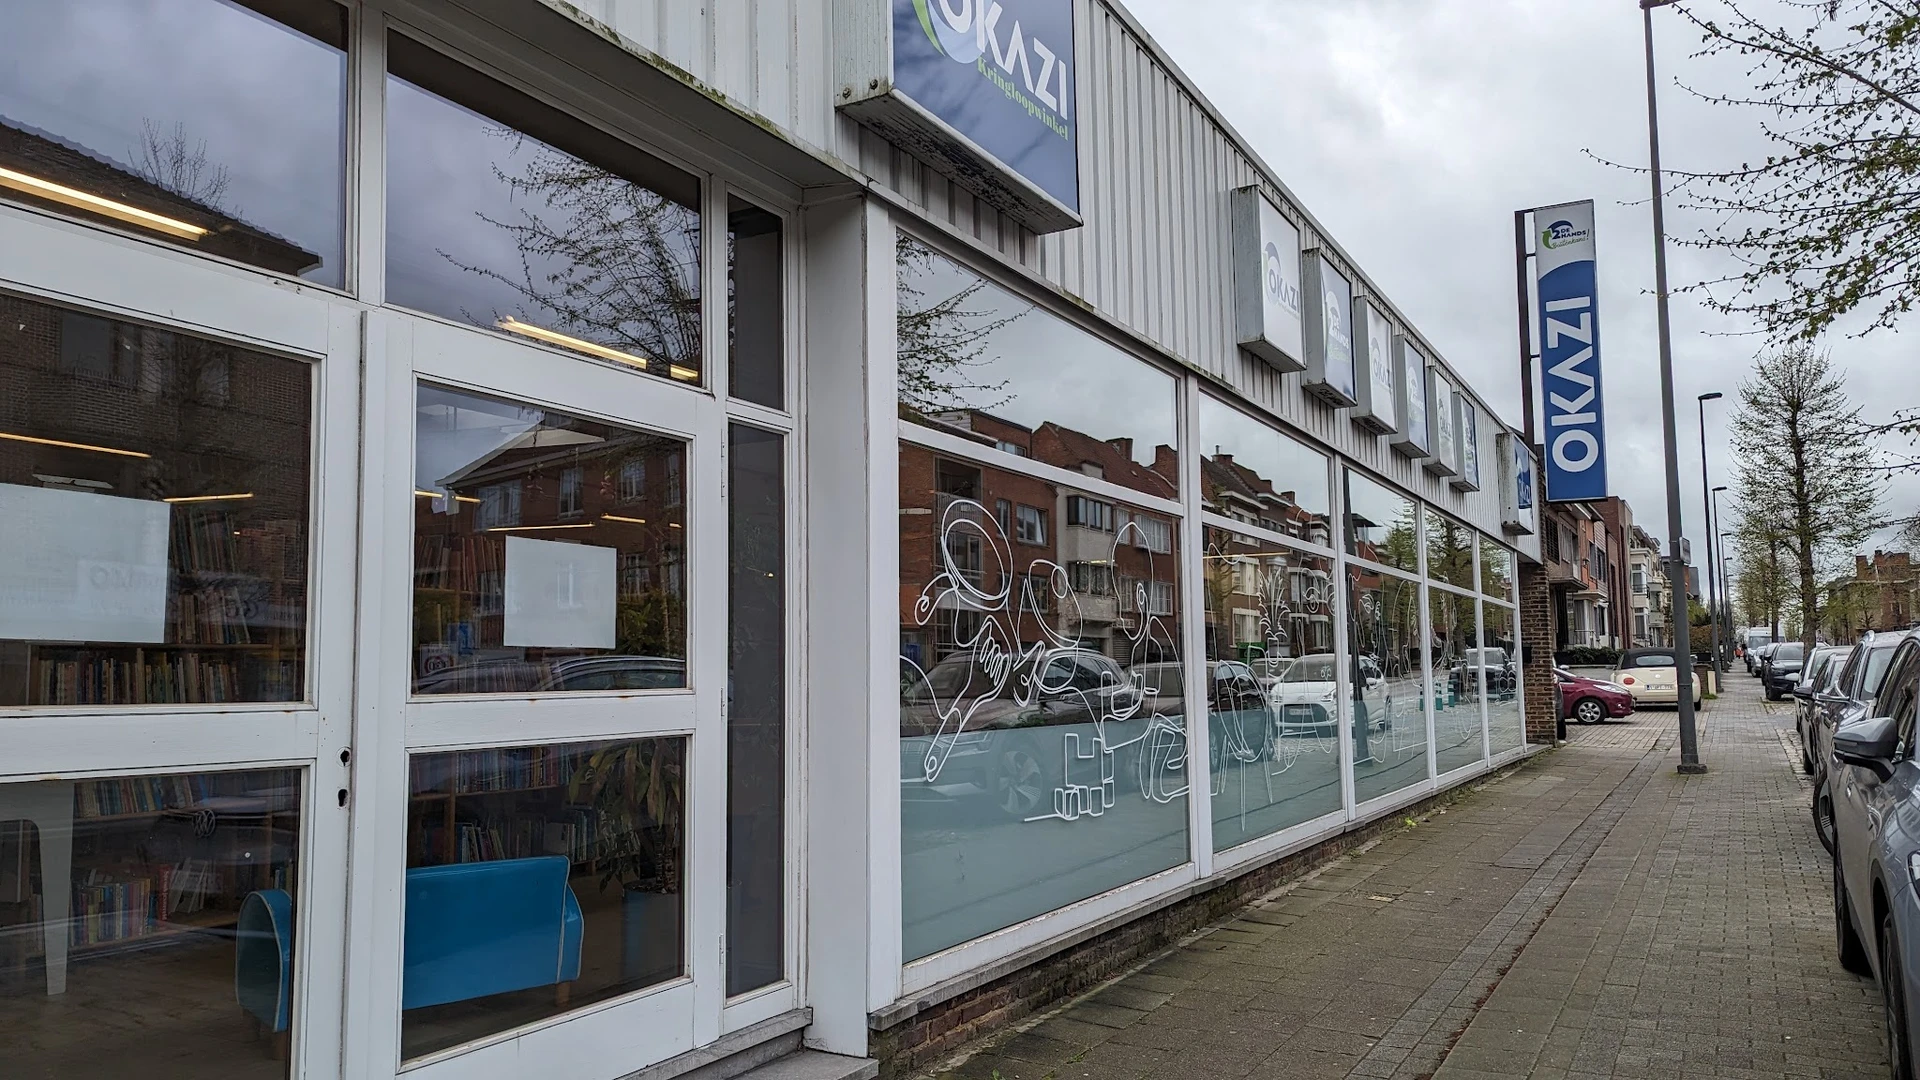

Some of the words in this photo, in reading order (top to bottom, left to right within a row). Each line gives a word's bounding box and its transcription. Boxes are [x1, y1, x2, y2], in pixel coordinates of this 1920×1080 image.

[977, 56, 1069, 142] Kringloopwinkel
[1268, 268, 1300, 314] OKAZI
[1546, 296, 1599, 473] OKAZI
